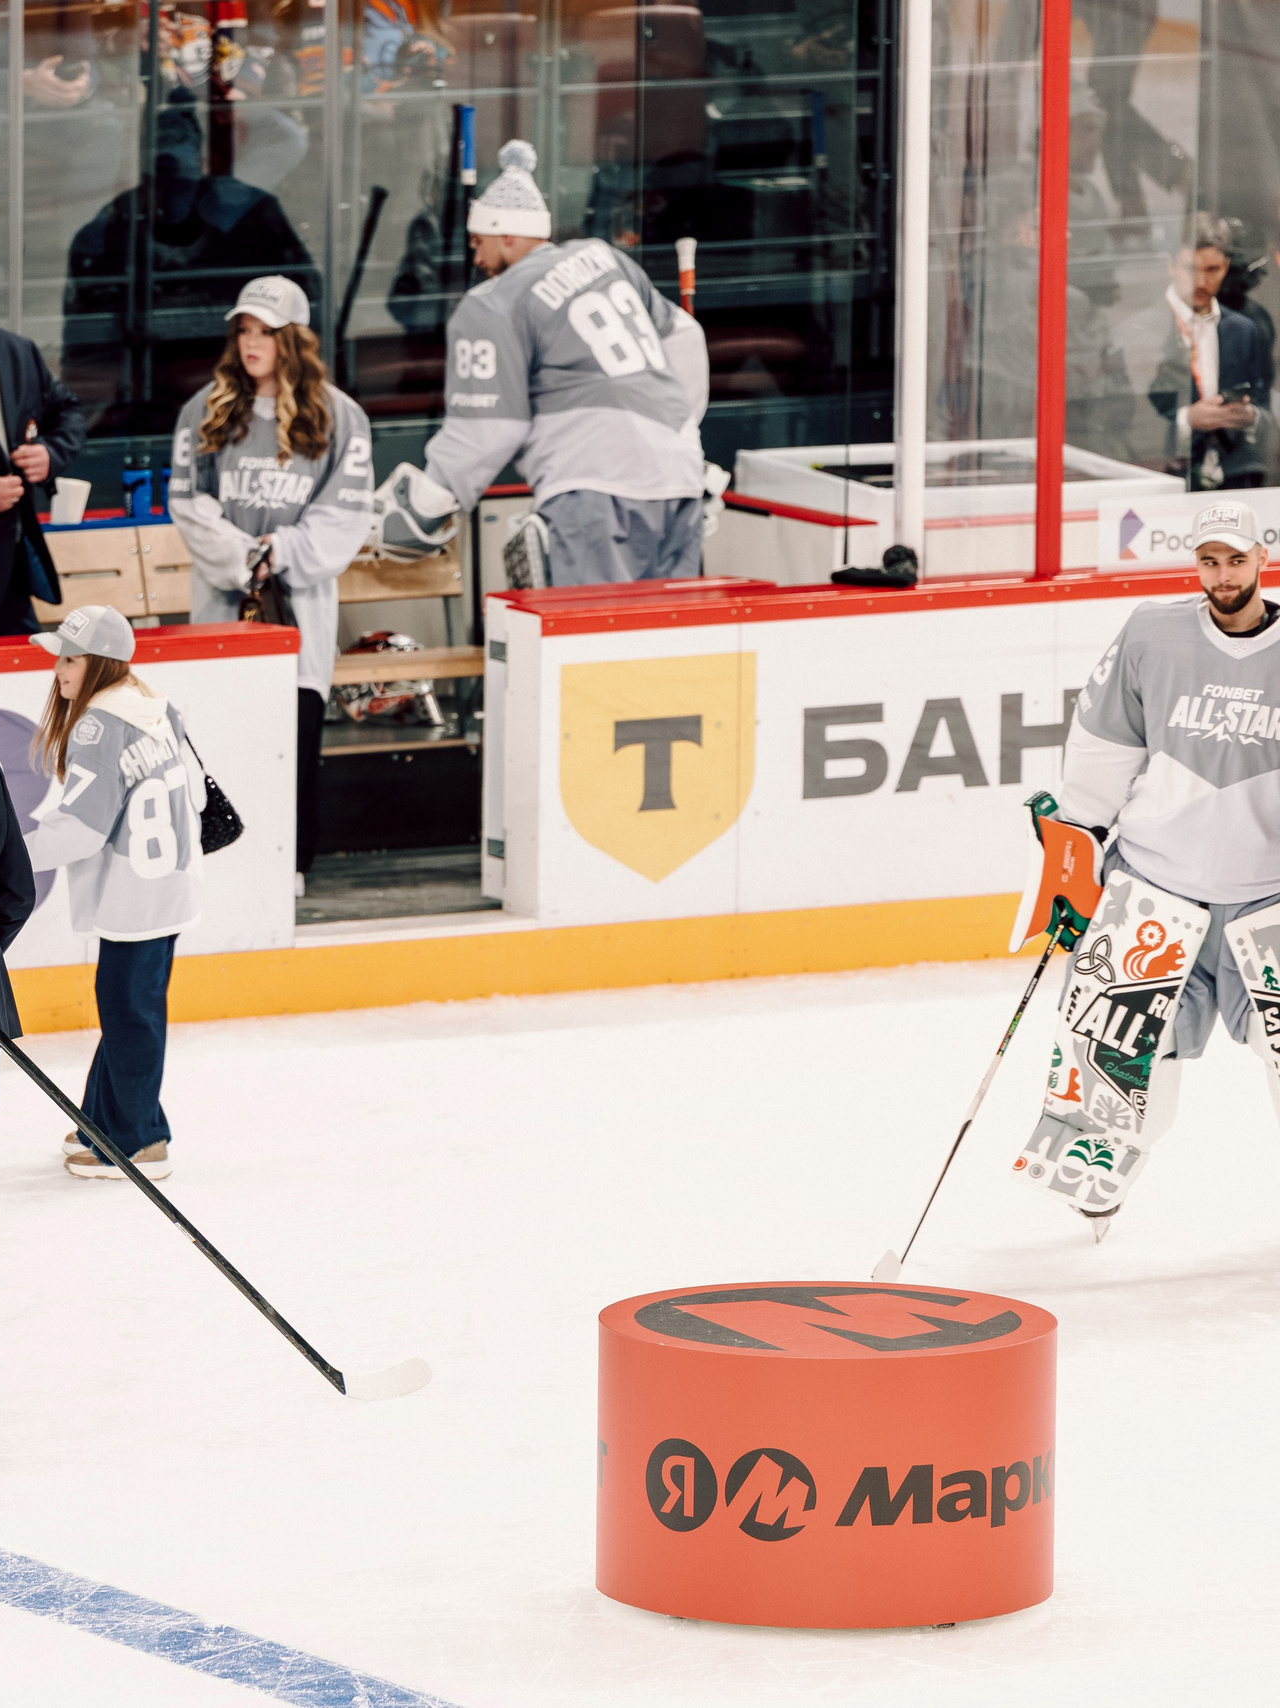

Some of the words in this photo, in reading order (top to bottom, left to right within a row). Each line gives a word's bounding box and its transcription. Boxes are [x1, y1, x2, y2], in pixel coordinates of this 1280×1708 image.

[568, 279, 667, 378] 83
[454, 338, 497, 380] 83
[258, 473, 315, 505] STAR
[1168, 695, 1216, 731] ALL
[1202, 684, 1265, 702] FONBET
[802, 687, 1084, 800] БАН
[61, 762, 98, 807] 7
[1075, 995, 1147, 1058] ALL
[835, 1450, 1055, 1528] Марк
